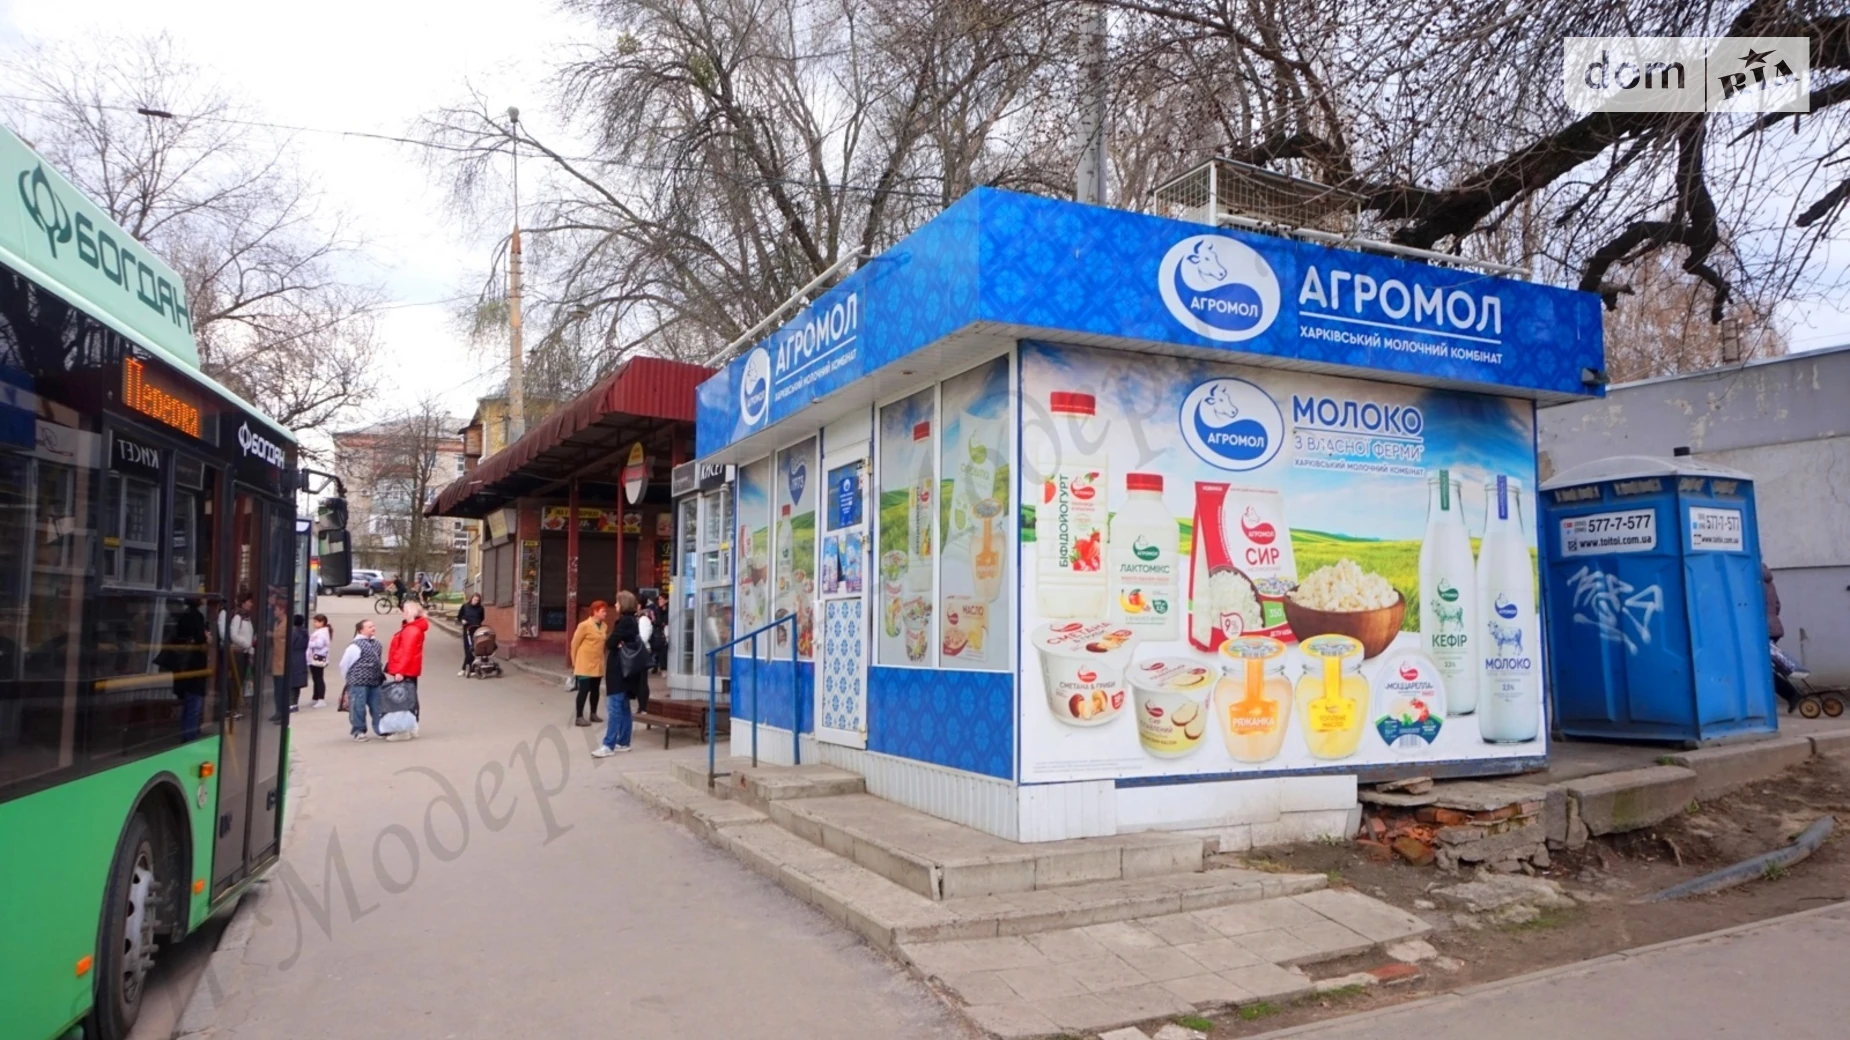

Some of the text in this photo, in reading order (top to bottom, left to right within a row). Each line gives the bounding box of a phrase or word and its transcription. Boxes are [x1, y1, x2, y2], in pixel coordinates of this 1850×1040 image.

[75, 211, 192, 335] БОГДАН
[1191, 296, 1258, 318] АГРОМОЛ
[1299, 265, 1501, 334] АГРОМОЛ
[775, 292, 857, 377] АГРОМОЛ
[1300, 325, 1503, 364] ХАРКІВСЬКИЙ МОЛОЧНИЙ КОМБІНАТ
[1292, 395, 1423, 436] МОЛОКО
[1207, 431, 1265, 448] АГРОМОЛ
[1295, 435, 1303, 450] З
[1308, 437, 1370, 456] ВЛАСНОЇ
[251, 433, 286, 468] БОГДАН
[1295, 459, 1424, 476] ХАРКІВСЬКИЙ МОЛОЧНИЙ КОМБІНАТ
[1059, 474, 1069, 567] БІФІДОЙОГУРТ
[1588, 514, 1651, 533] 577-7-577
[1580, 536, 1652, 548] www.toitoi.com.ua
[1246, 547, 1280, 565] СИР
[1120, 564, 1170, 574] ЛАКТОМІКС
[1432, 633, 1468, 648] КЕФІР
[1485, 658, 1531, 670] МОЛОКО
[1059, 681, 1089, 690] СМЕТАНА
[1233, 717, 1275, 726] РЯЖАНКА
